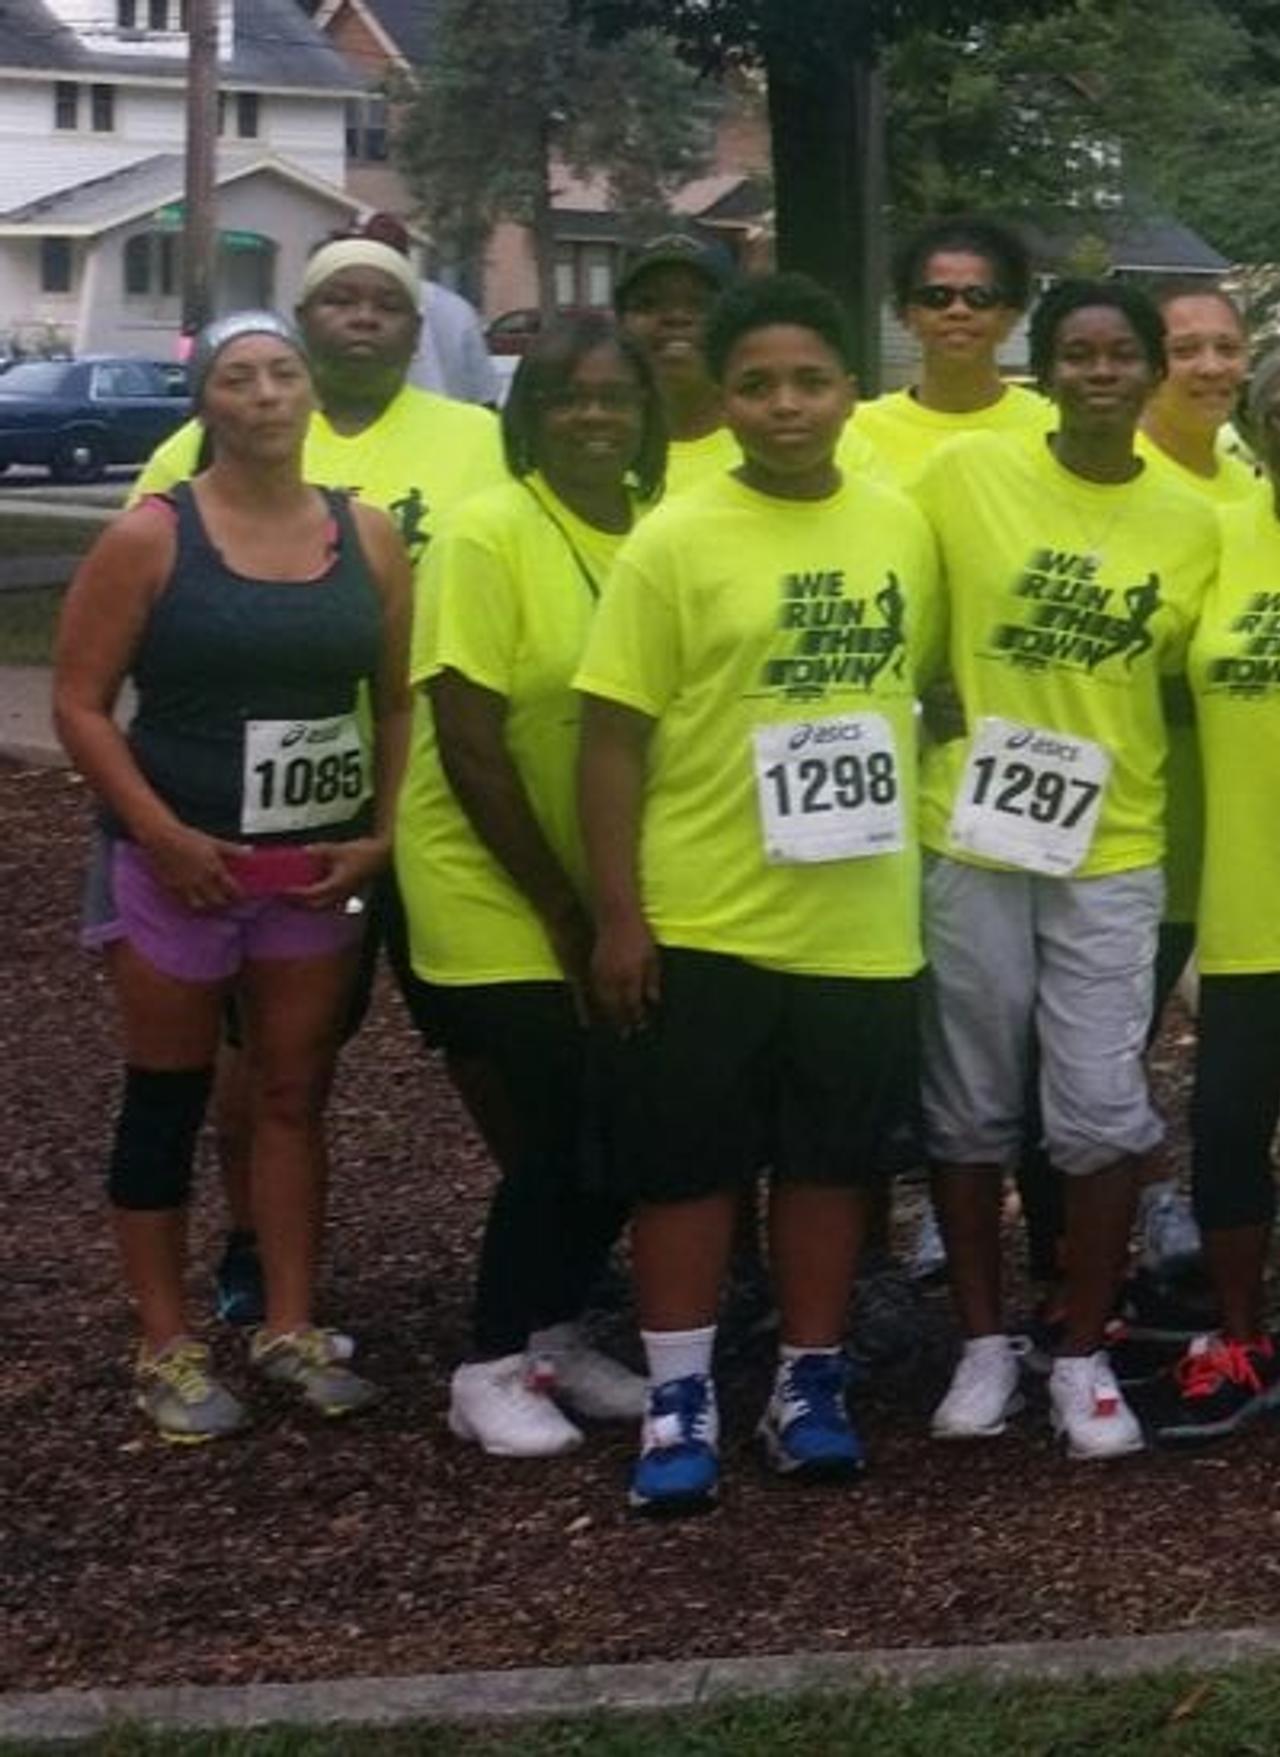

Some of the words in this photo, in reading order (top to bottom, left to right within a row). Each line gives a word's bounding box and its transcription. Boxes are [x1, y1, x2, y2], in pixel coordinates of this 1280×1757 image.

[1034, 550, 1098, 580] WE
[783, 571, 845, 598] WE
[1016, 572, 1114, 610] RUN
[782, 599, 866, 630] RUN
[254, 749, 363, 810] 1085
[766, 752, 896, 816] 1298
[974, 756, 1100, 828] 1297
